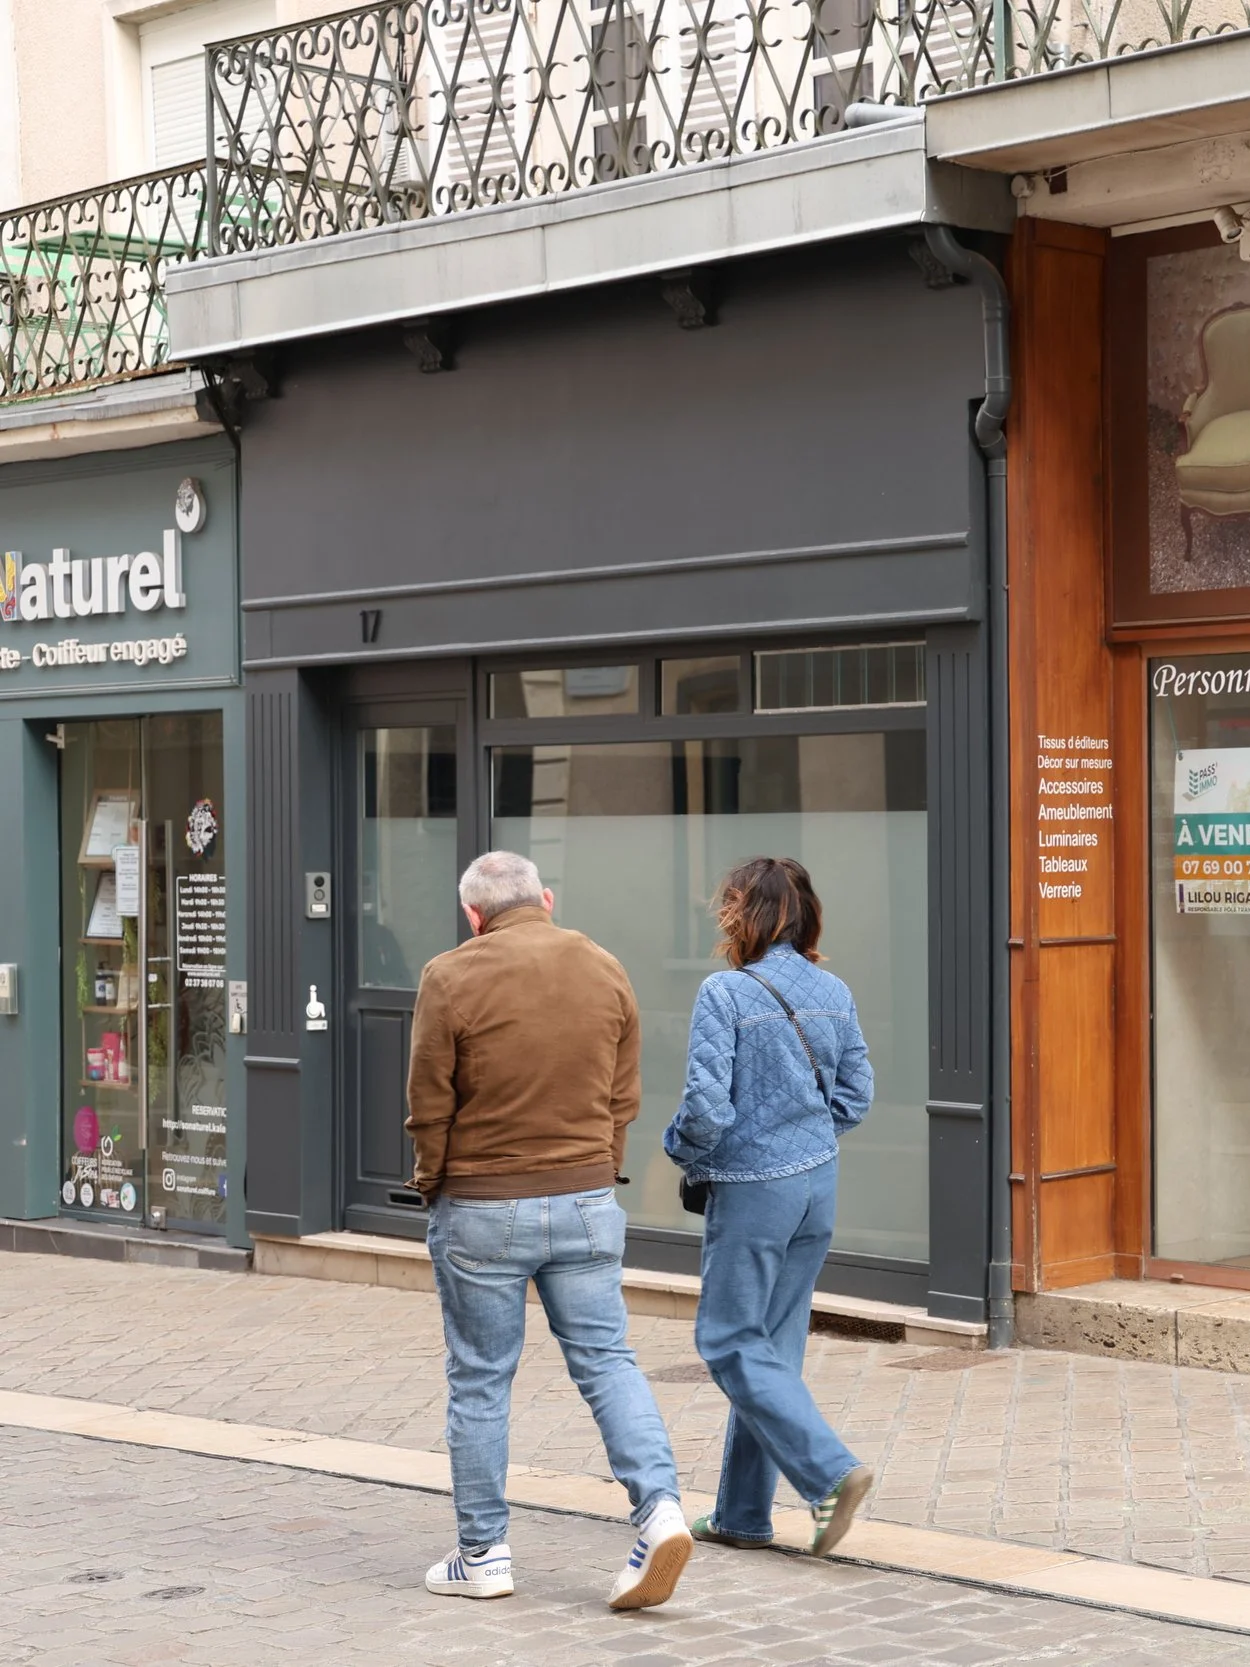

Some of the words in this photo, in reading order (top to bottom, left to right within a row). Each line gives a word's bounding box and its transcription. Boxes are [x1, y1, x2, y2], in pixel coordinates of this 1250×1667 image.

[359, 609, 382, 643] 17
[32, 638, 109, 667] Coiffeur
[110, 633, 187, 666] engagé
[1038, 735, 1066, 749] Tissus
[1038, 755, 1063, 769] Décor
[1065, 758, 1079, 769] sur
[1081, 758, 1113, 769] mesure
[1038, 777, 1103, 794] Accessoires
[1038, 803, 1113, 820] Ameublement
[1039, 830, 1098, 847] Luminaires
[1177, 819, 1193, 846] À
[1039, 856, 1088, 873] Tableaux
[1182, 860, 1199, 875] 07
[1202, 860, 1220, 875] 69
[1223, 860, 1243, 875] 00
[189, 873, 217, 882] HORAIRES
[1039, 881, 1082, 898] Verrerie
[1188, 892, 1221, 903] LILOU
